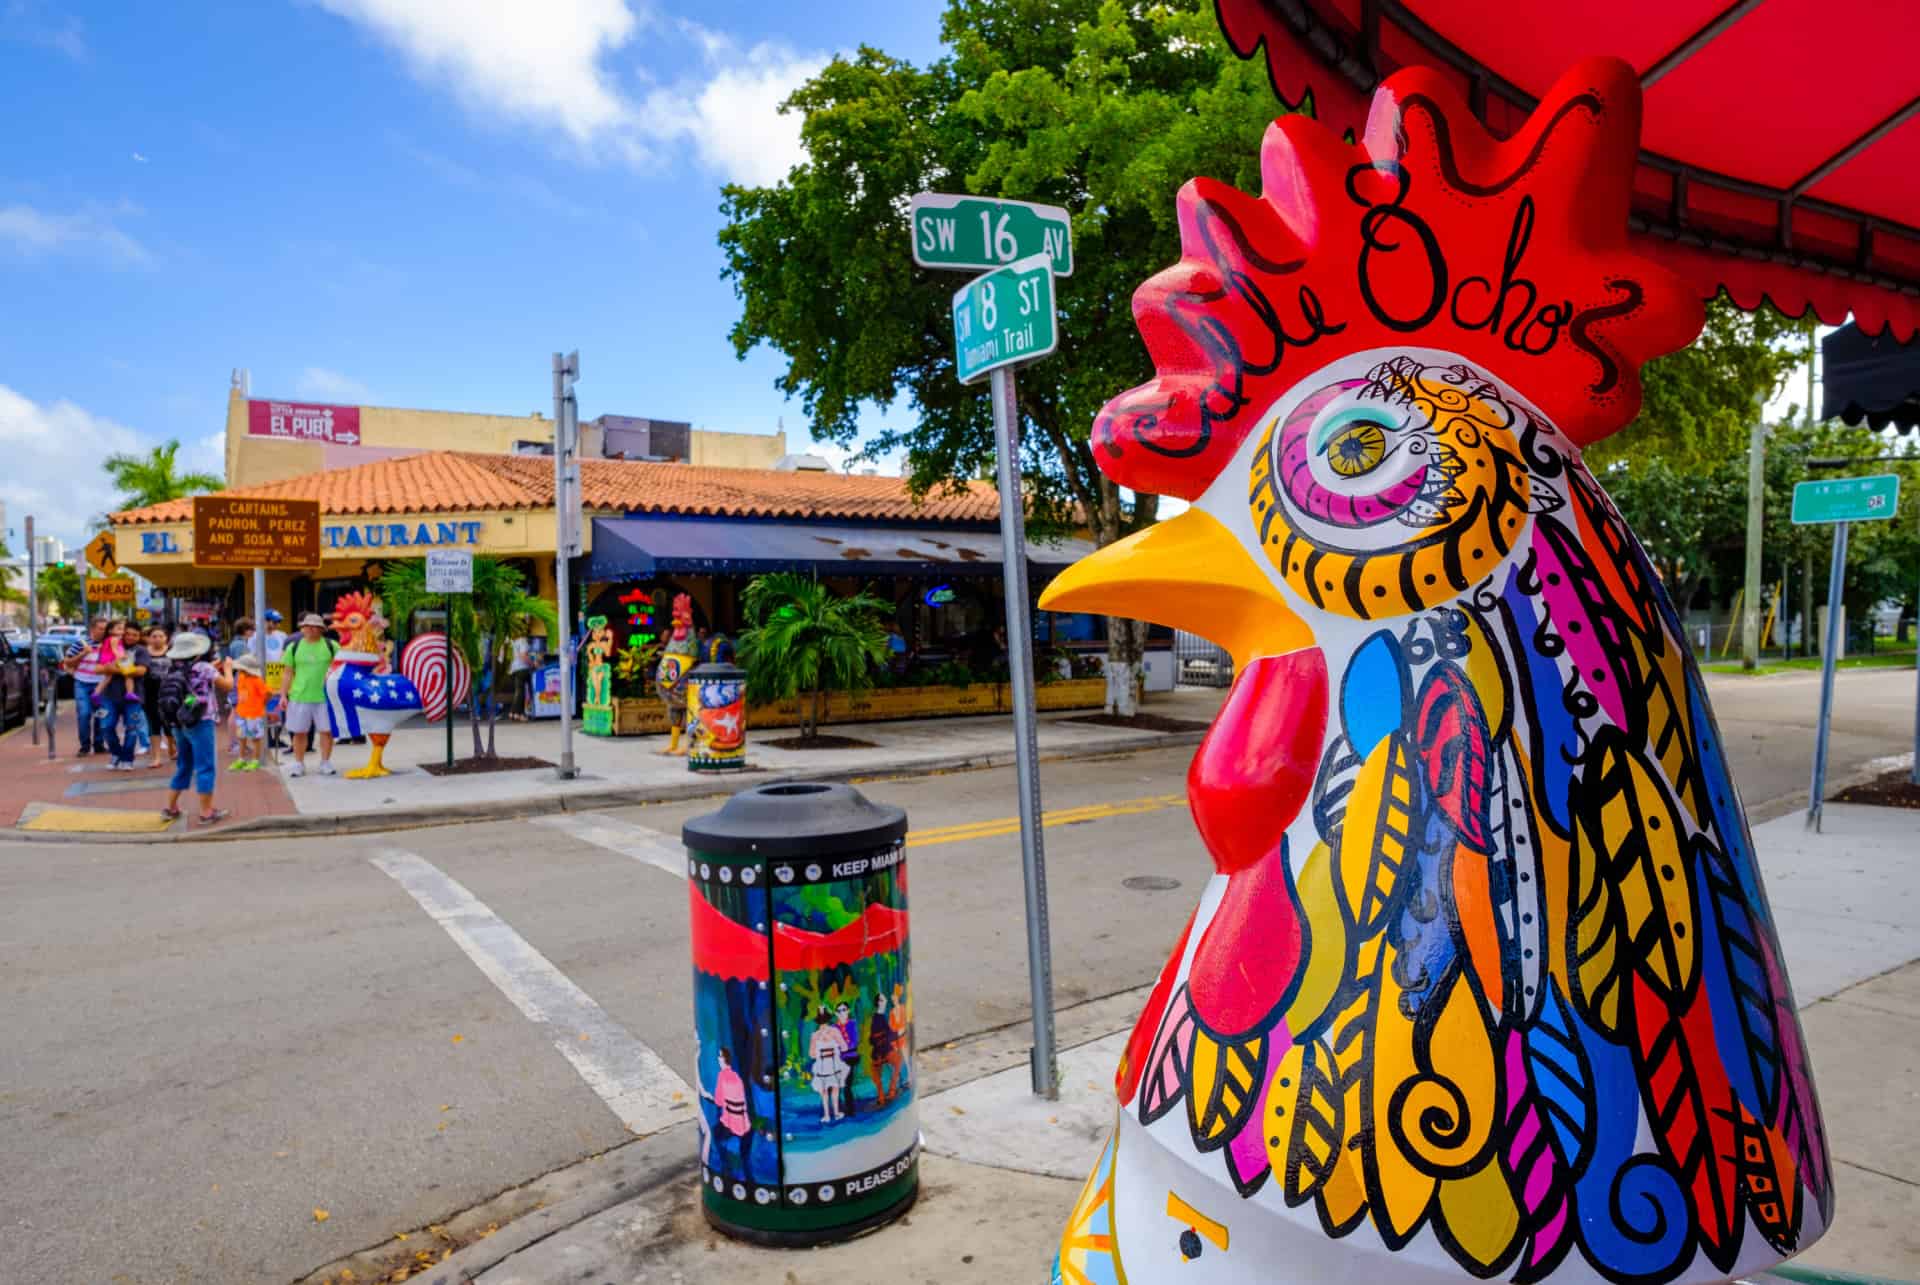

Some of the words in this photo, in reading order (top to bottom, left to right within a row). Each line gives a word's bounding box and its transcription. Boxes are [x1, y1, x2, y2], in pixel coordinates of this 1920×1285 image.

[920, 216, 955, 252] SW
[980, 210, 1018, 262] 16
[1043, 227, 1063, 261] AV
[981, 281, 997, 331] 8
[1018, 277, 1040, 316] ST
[1133, 270, 1348, 458] Calle
[1345, 163, 1574, 355] Ocho
[1003, 322, 1034, 354] Trail
[271, 415, 289, 433] EL
[141, 532, 177, 553] EL
[324, 522, 481, 548] TAURANT
[209, 533, 234, 545] AND
[243, 534, 275, 546] SOSA
[282, 535, 306, 547] WAY
[88, 583, 132, 594] AHEAD
[832, 859, 869, 877] KEEP
[846, 1166, 895, 1196] PLEASE
